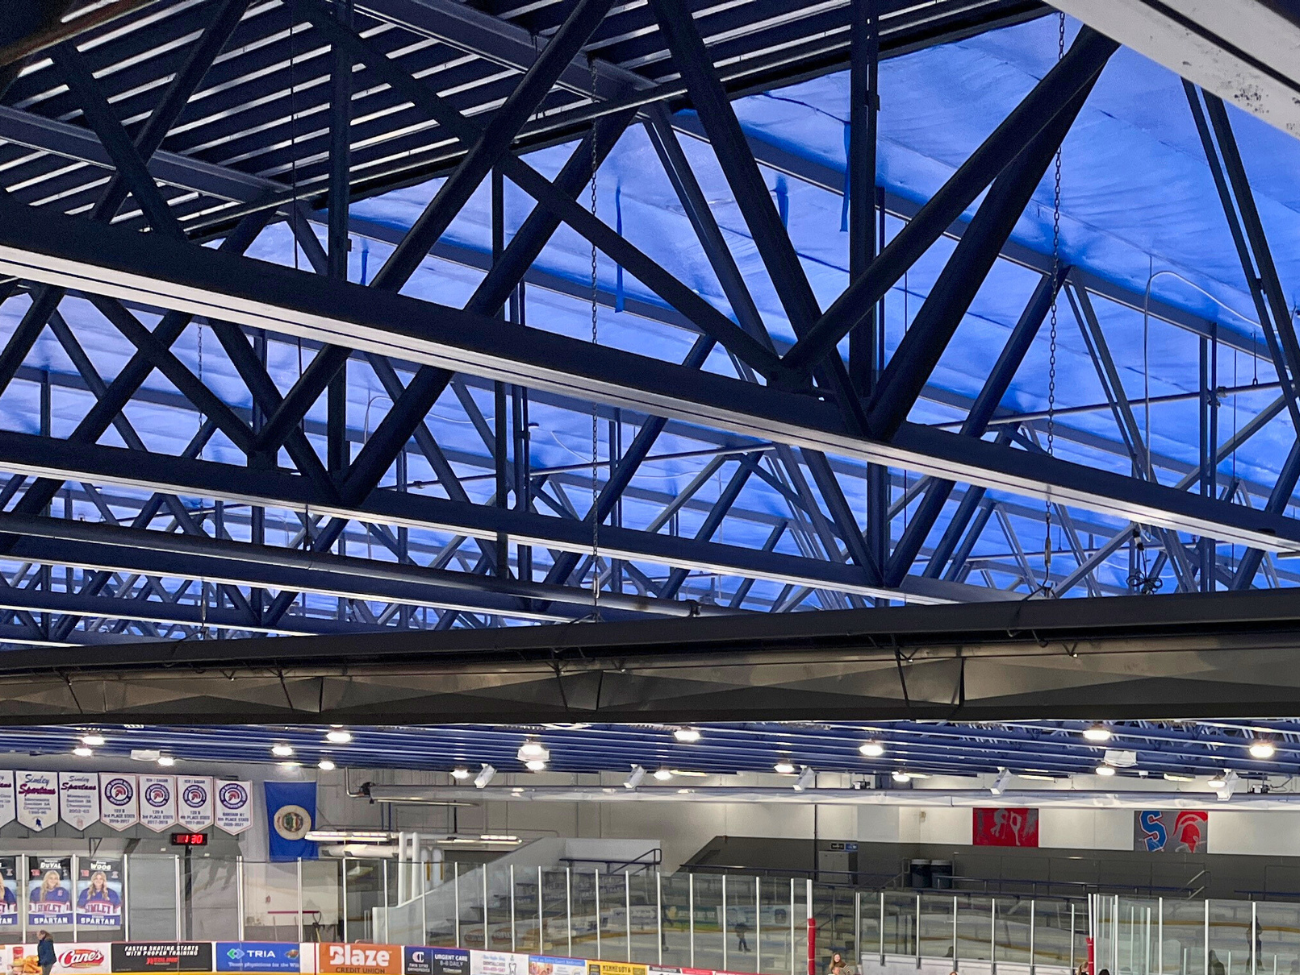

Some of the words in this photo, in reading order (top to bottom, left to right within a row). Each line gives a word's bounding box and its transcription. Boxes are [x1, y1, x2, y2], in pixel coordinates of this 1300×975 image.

[18, 783, 57, 797] Spartans
[61, 782, 97, 791] Spartans
[34, 917, 68, 925] SPARTAN
[80, 917, 115, 925] SPARTAN
[60, 949, 101, 968] Cane's
[247, 950, 276, 958] TRIA
[329, 945, 390, 967] Blaze
